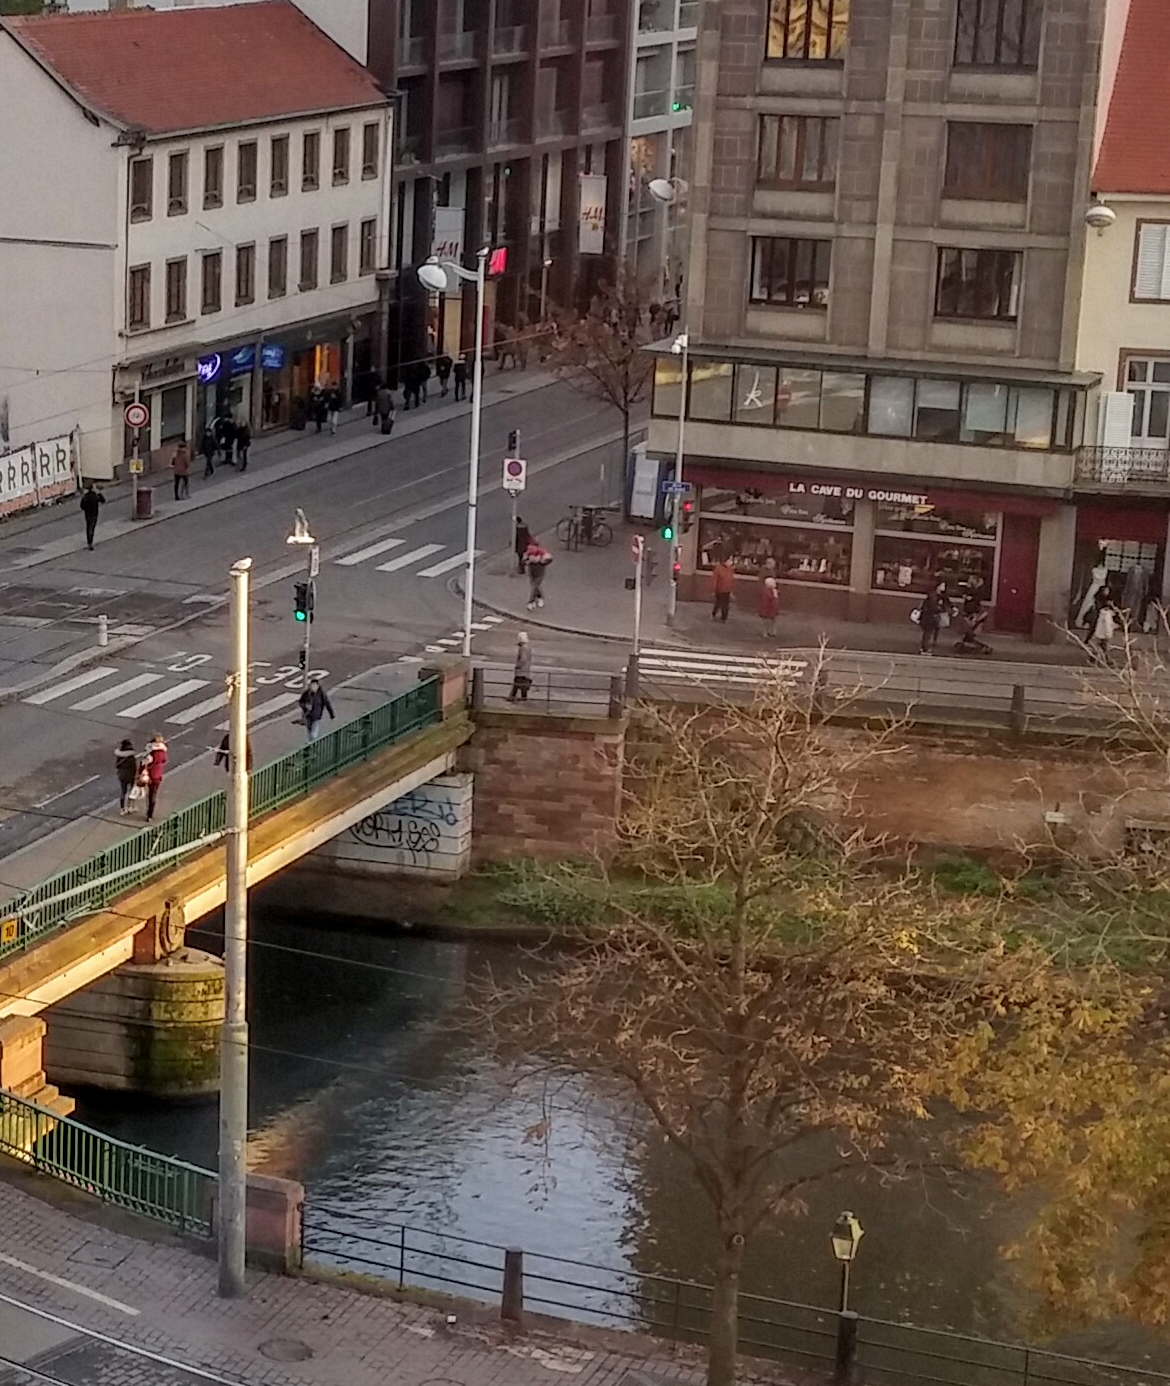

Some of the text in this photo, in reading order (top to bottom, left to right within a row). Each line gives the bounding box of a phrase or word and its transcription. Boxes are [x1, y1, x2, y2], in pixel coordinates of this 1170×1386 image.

[789, 482, 928, 505] LA CAVE DU GOURMET
